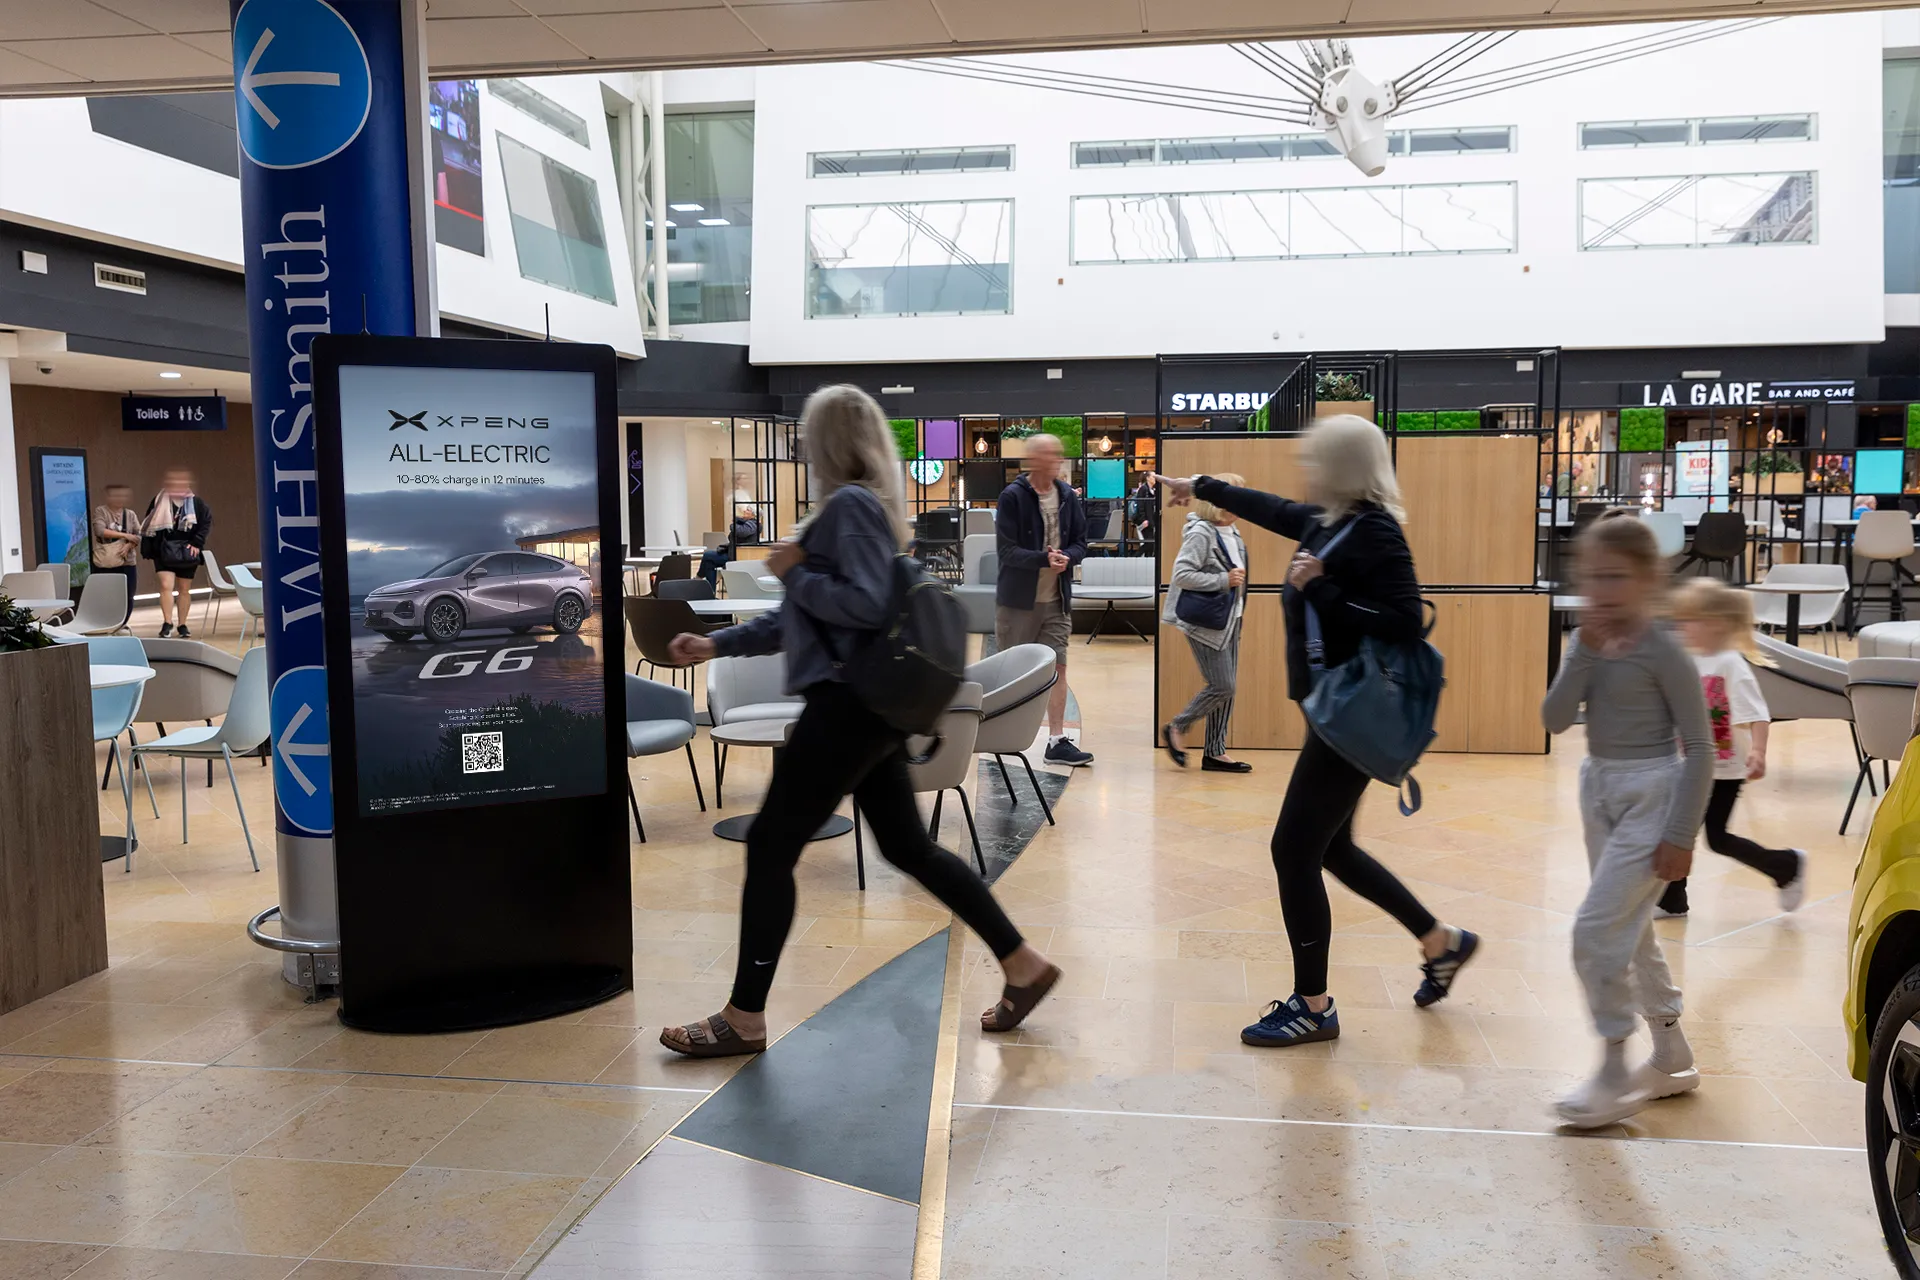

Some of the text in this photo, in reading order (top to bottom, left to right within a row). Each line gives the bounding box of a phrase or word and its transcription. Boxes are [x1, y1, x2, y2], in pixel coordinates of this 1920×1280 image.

[1171, 392, 1269, 411] STARBU
[1643, 382, 1763, 406] LA GARE
[1768, 387, 1855, 398] BAR AND CAFÉ
[136, 408, 170, 419] Toilets
[262, 204, 330, 632] WHSmith
[437, 415, 549, 429] XPENG
[389, 443, 551, 463] ALL-ELECTRIC
[396, 474, 545, 486] 10-80% charge in 12 minutes
[418, 645, 539, 679] G6
